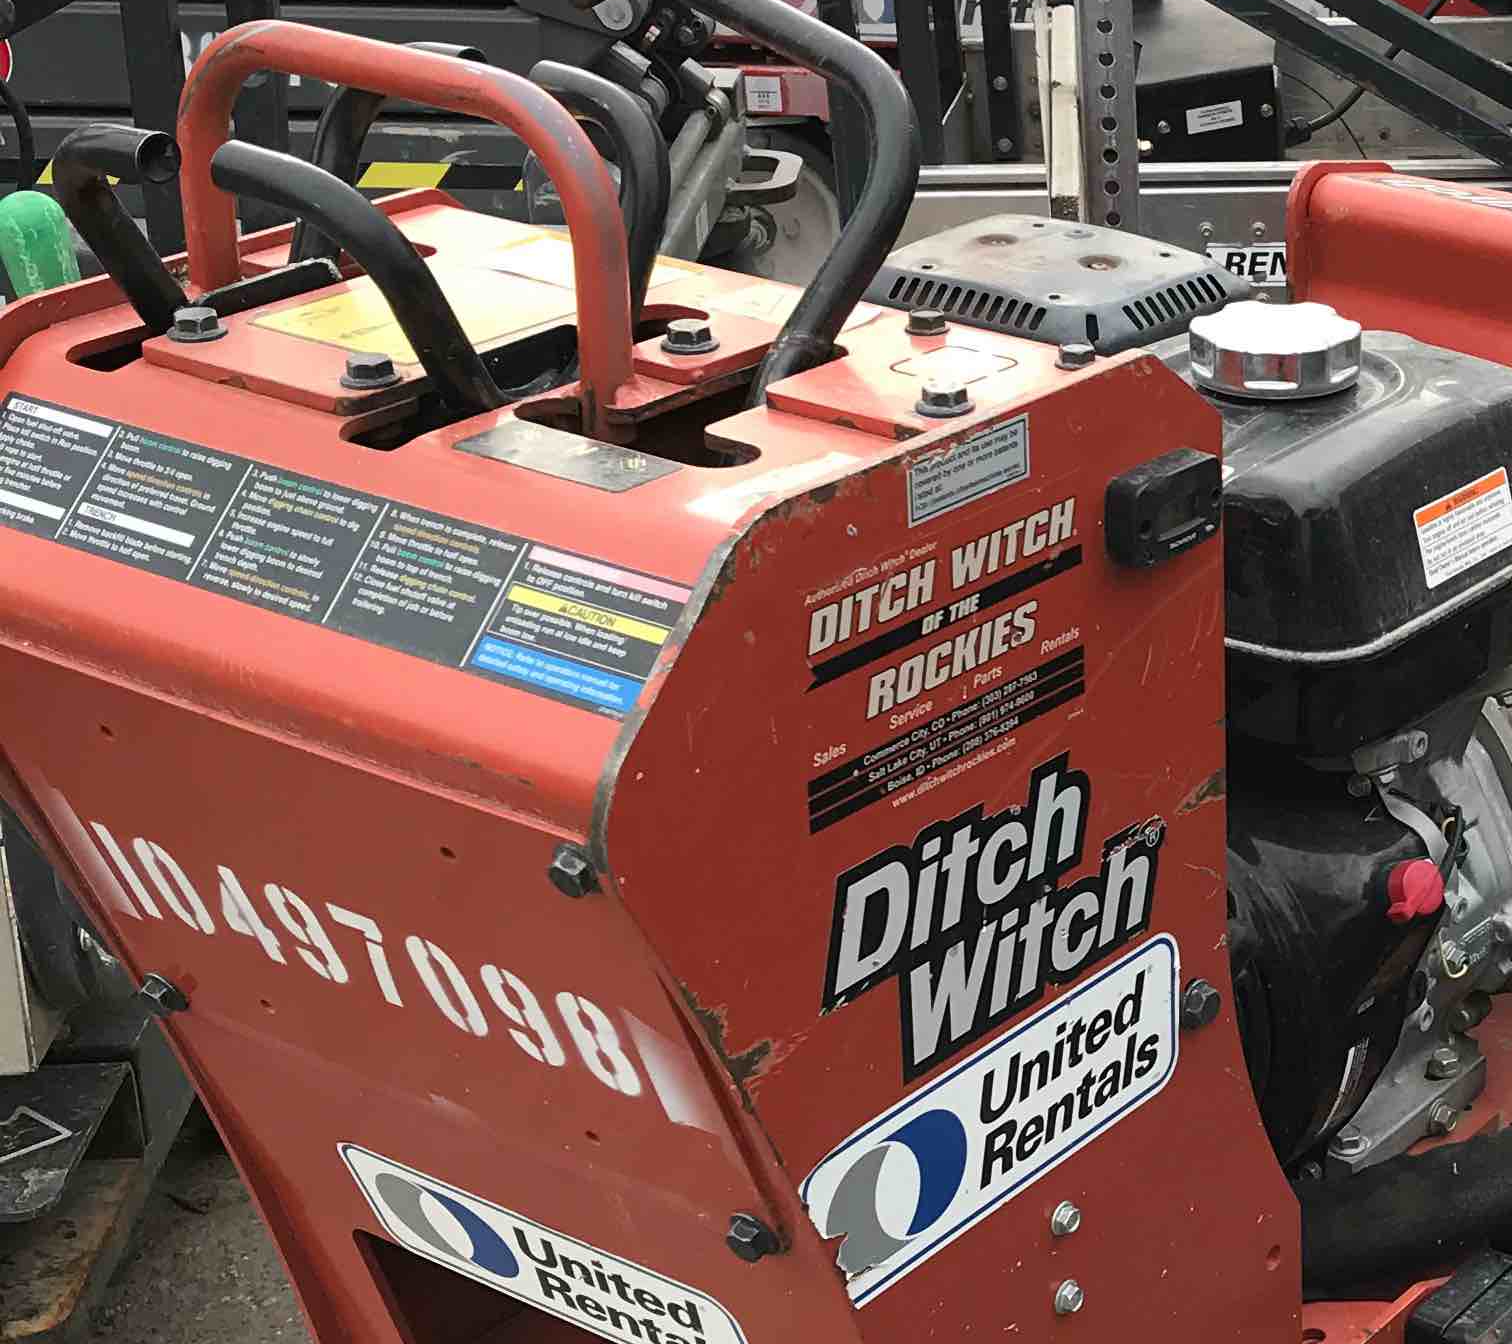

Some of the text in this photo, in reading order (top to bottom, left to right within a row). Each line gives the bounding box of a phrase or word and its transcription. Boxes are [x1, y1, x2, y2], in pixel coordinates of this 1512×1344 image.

[567, 603, 617, 627] CAUTION
[808, 497, 1077, 656] DITCH WITCH
[920, 593, 981, 636] OF THE
[866, 600, 1039, 720] ROCKIES
[973, 665, 1004, 689] Parts
[1040, 626, 1081, 656] Rentals
[888, 699, 935, 730] Service
[931, 717, 946, 734] CO
[813, 742, 849, 768] Sales
[868, 767, 887, 784] Salt
[886, 756, 909, 777] Lake
[929, 737, 944, 754] UT
[833, 770, 1083, 998] Ditch
[90, 821, 641, 1097] 10497098
[908, 846, 1151, 1068] Witch
[979, 969, 1147, 1125] United
[979, 1031, 1161, 1191] Rentals
[512, 1227, 704, 1334] United
